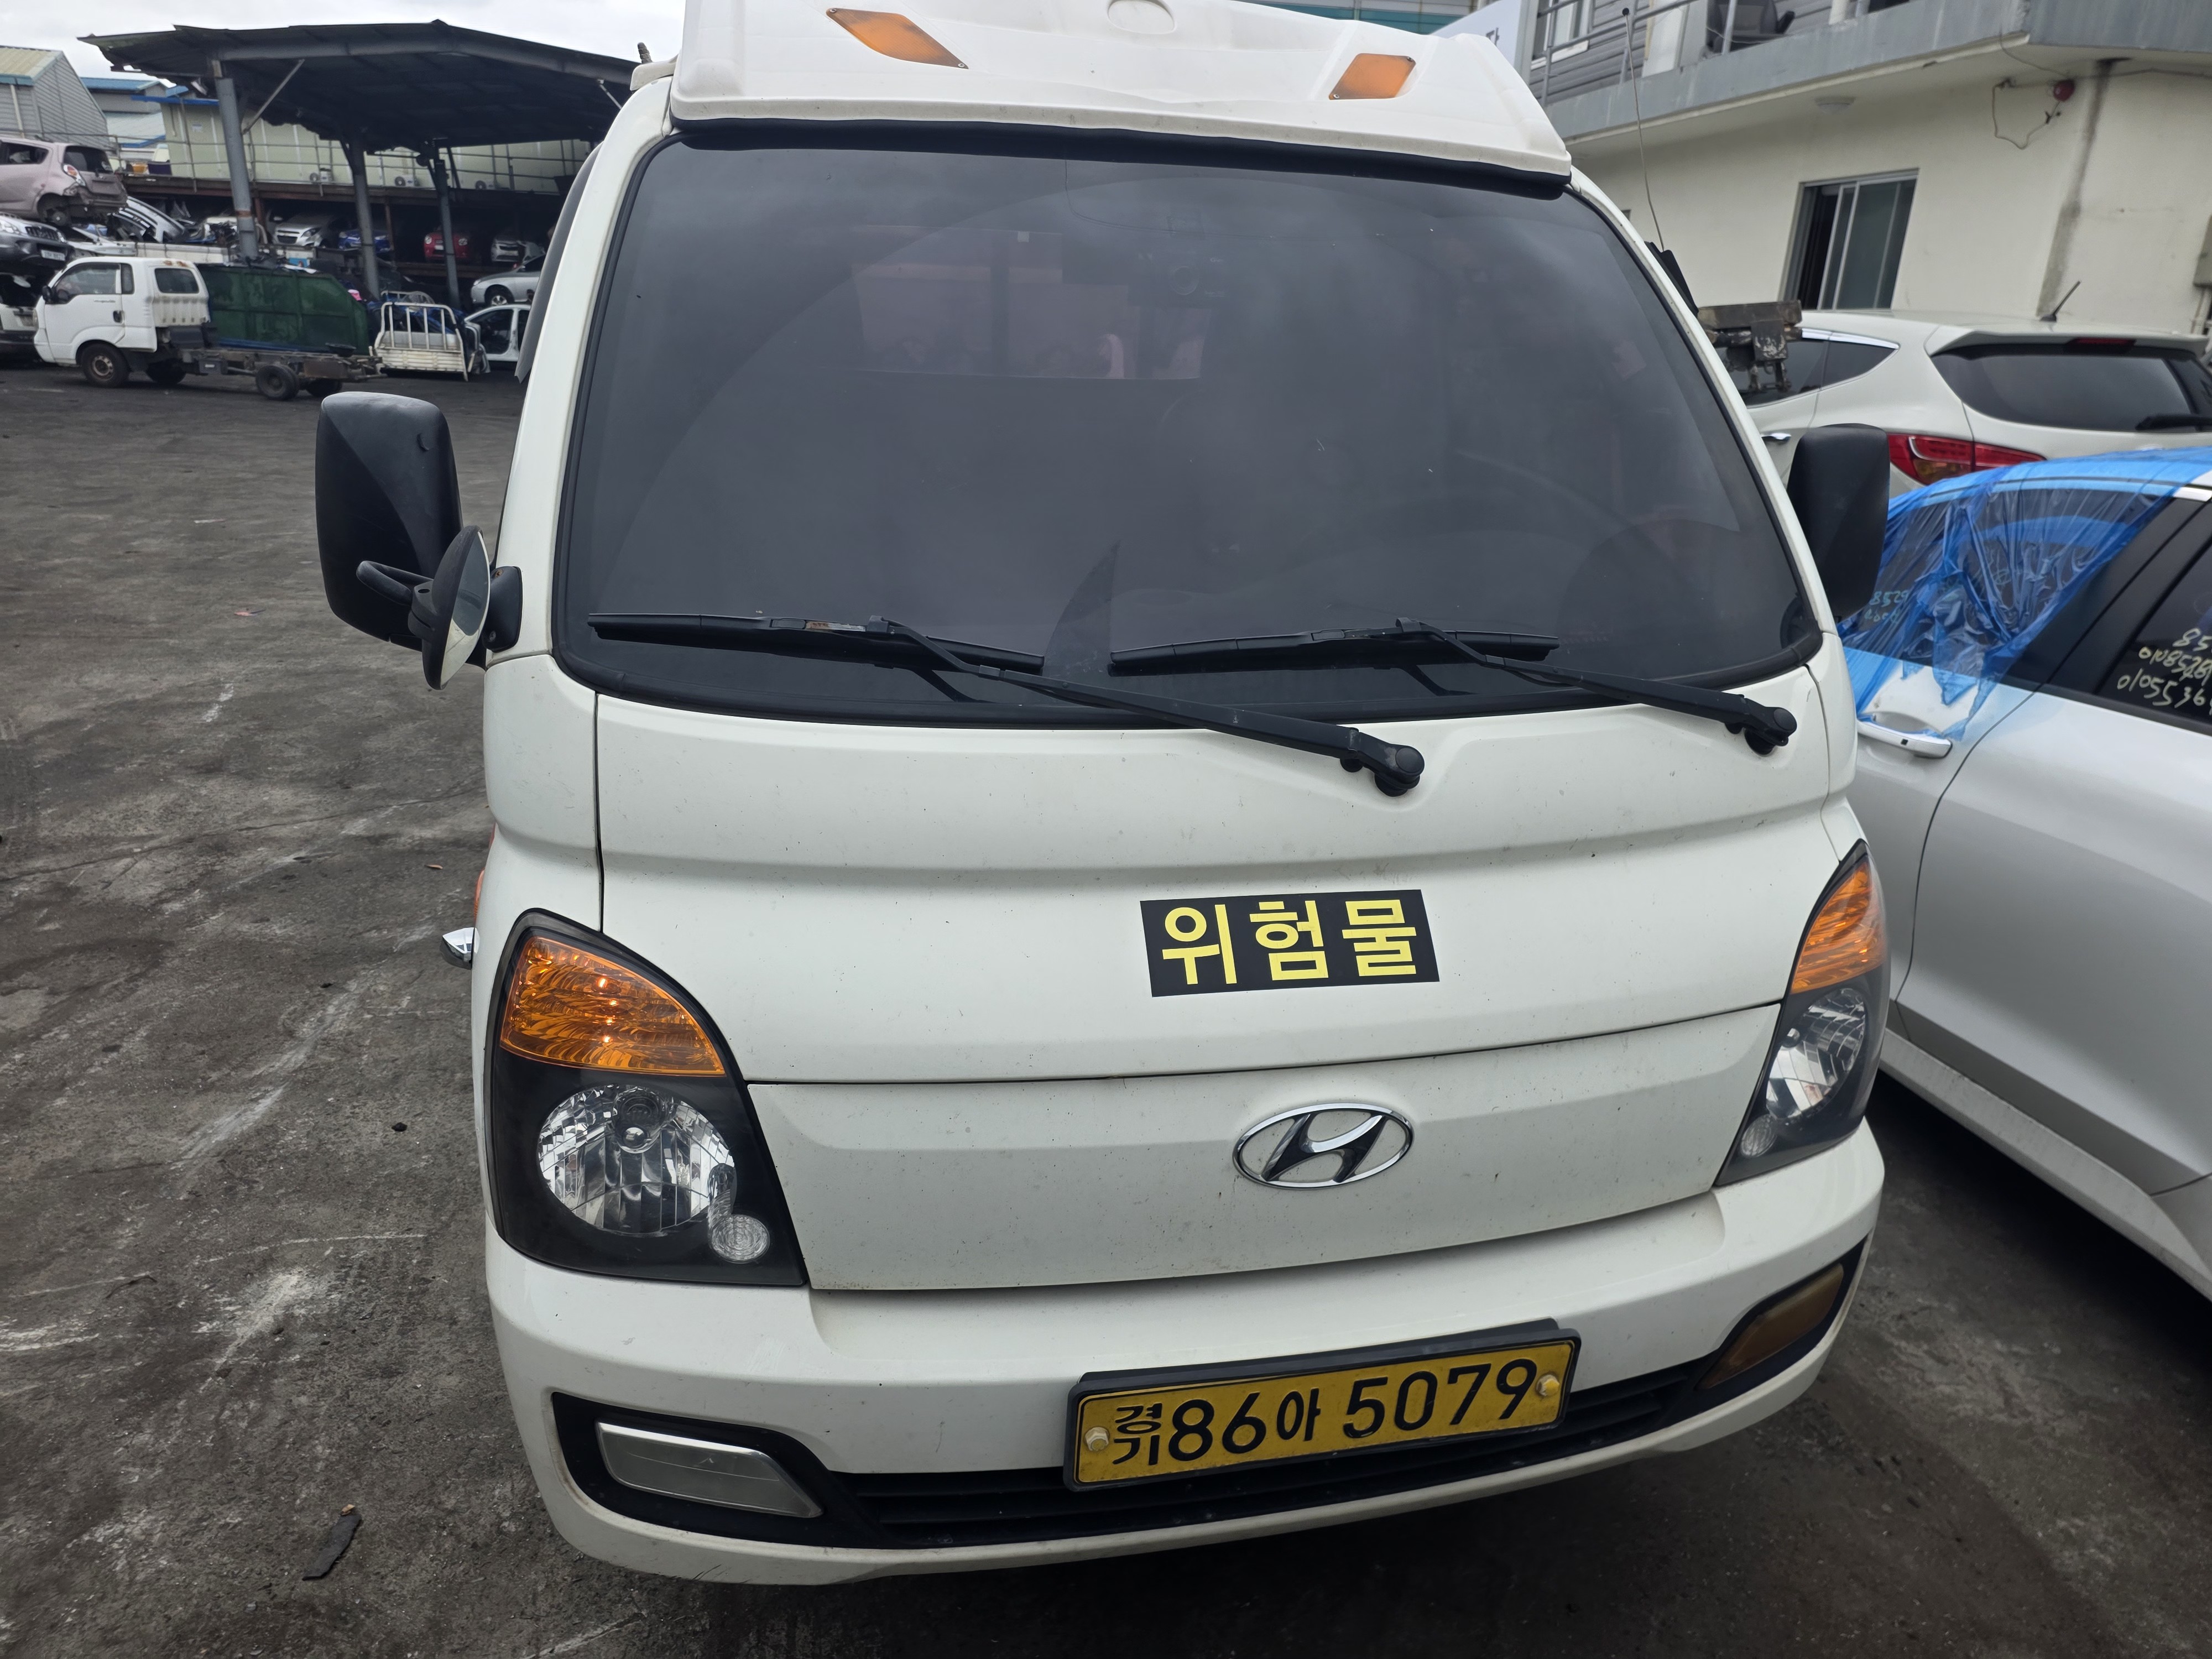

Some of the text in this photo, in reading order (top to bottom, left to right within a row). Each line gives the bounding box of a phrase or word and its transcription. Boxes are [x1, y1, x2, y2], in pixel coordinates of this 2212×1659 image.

[2172, 628, 2212, 651] 85
[1162, 899, 1417, 985] 위험물
[1342, 1358, 1538, 1438] 5079
